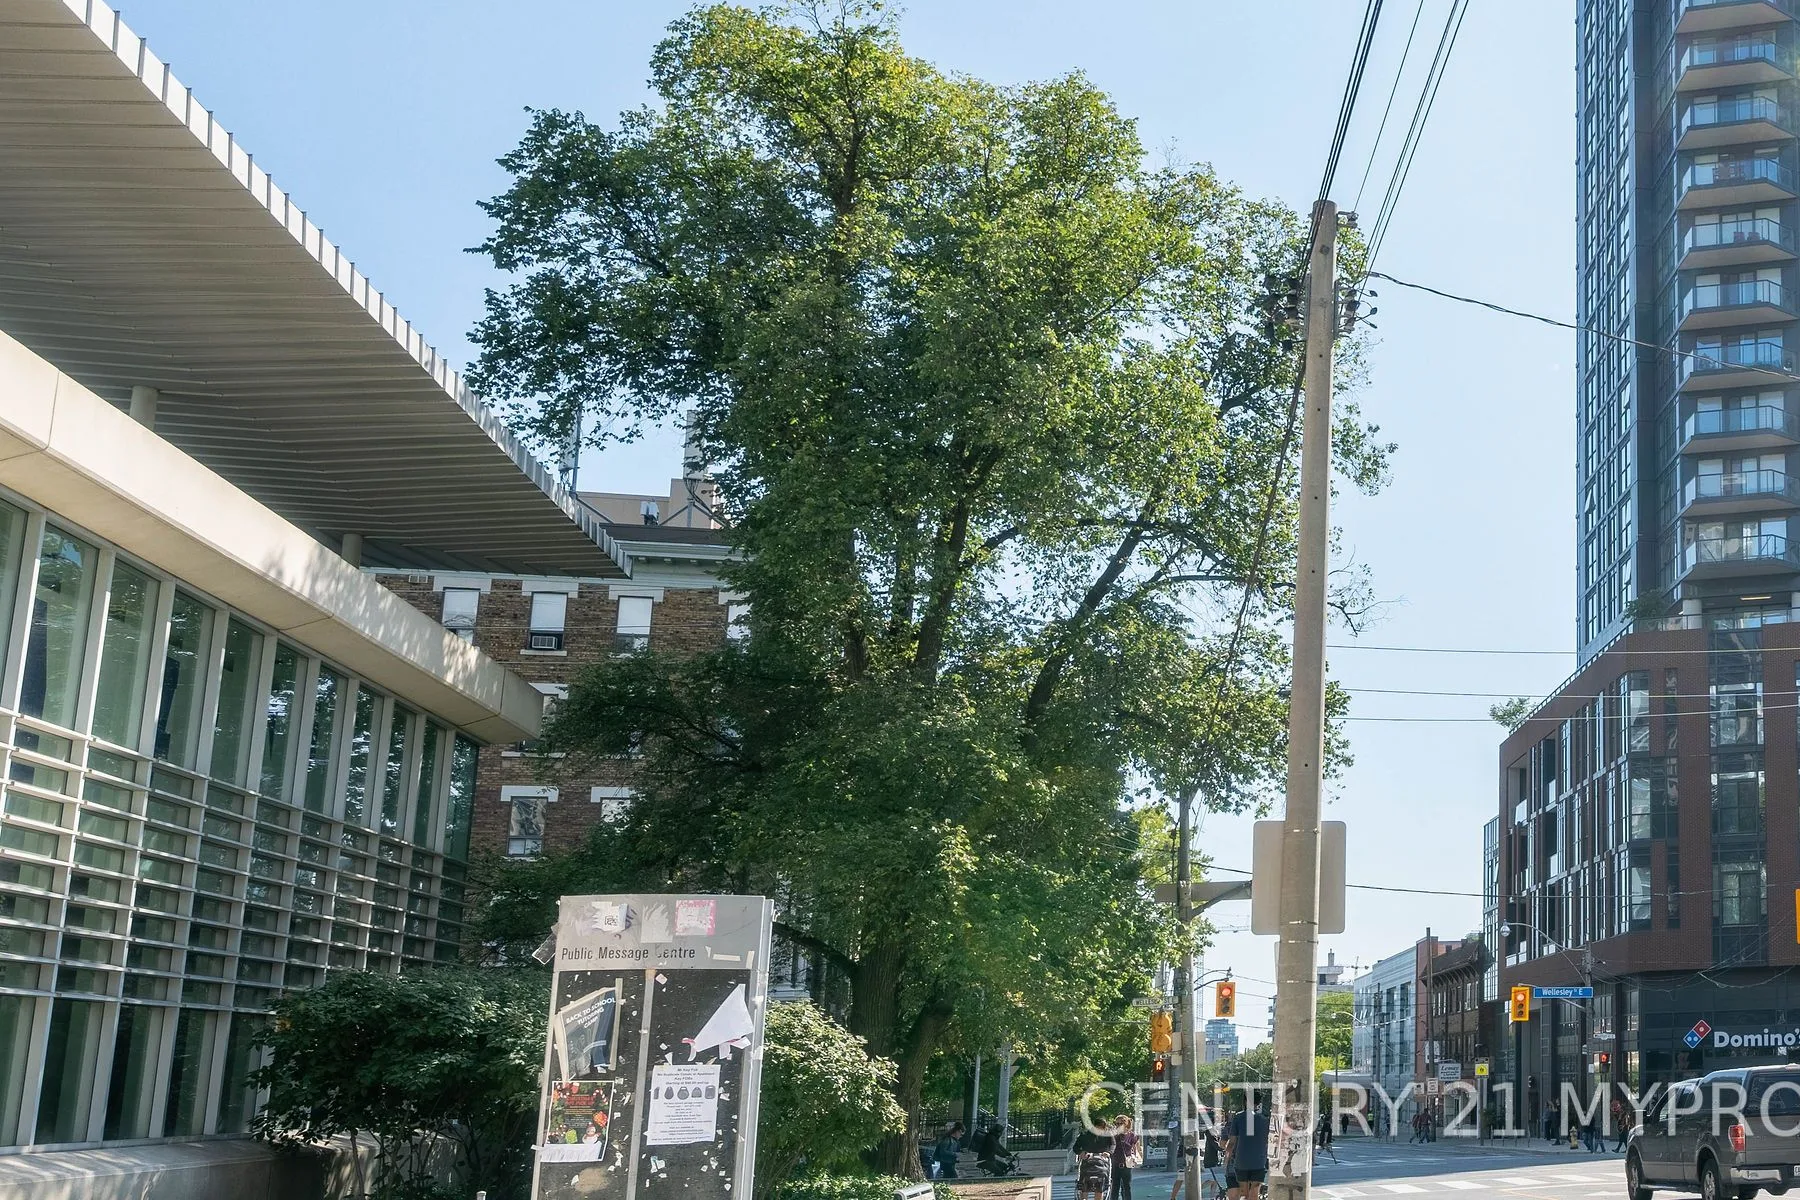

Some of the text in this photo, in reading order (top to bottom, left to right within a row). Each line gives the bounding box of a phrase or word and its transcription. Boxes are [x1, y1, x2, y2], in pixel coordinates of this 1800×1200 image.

[561, 947, 593, 960] Public
[598, 946, 649, 961] Message
[1541, 987, 1573, 998] Wellesley
[1578, 987, 1583, 996] E
[566, 1011, 583, 1024] BACK
[591, 997, 617, 1011] SCHOOL
